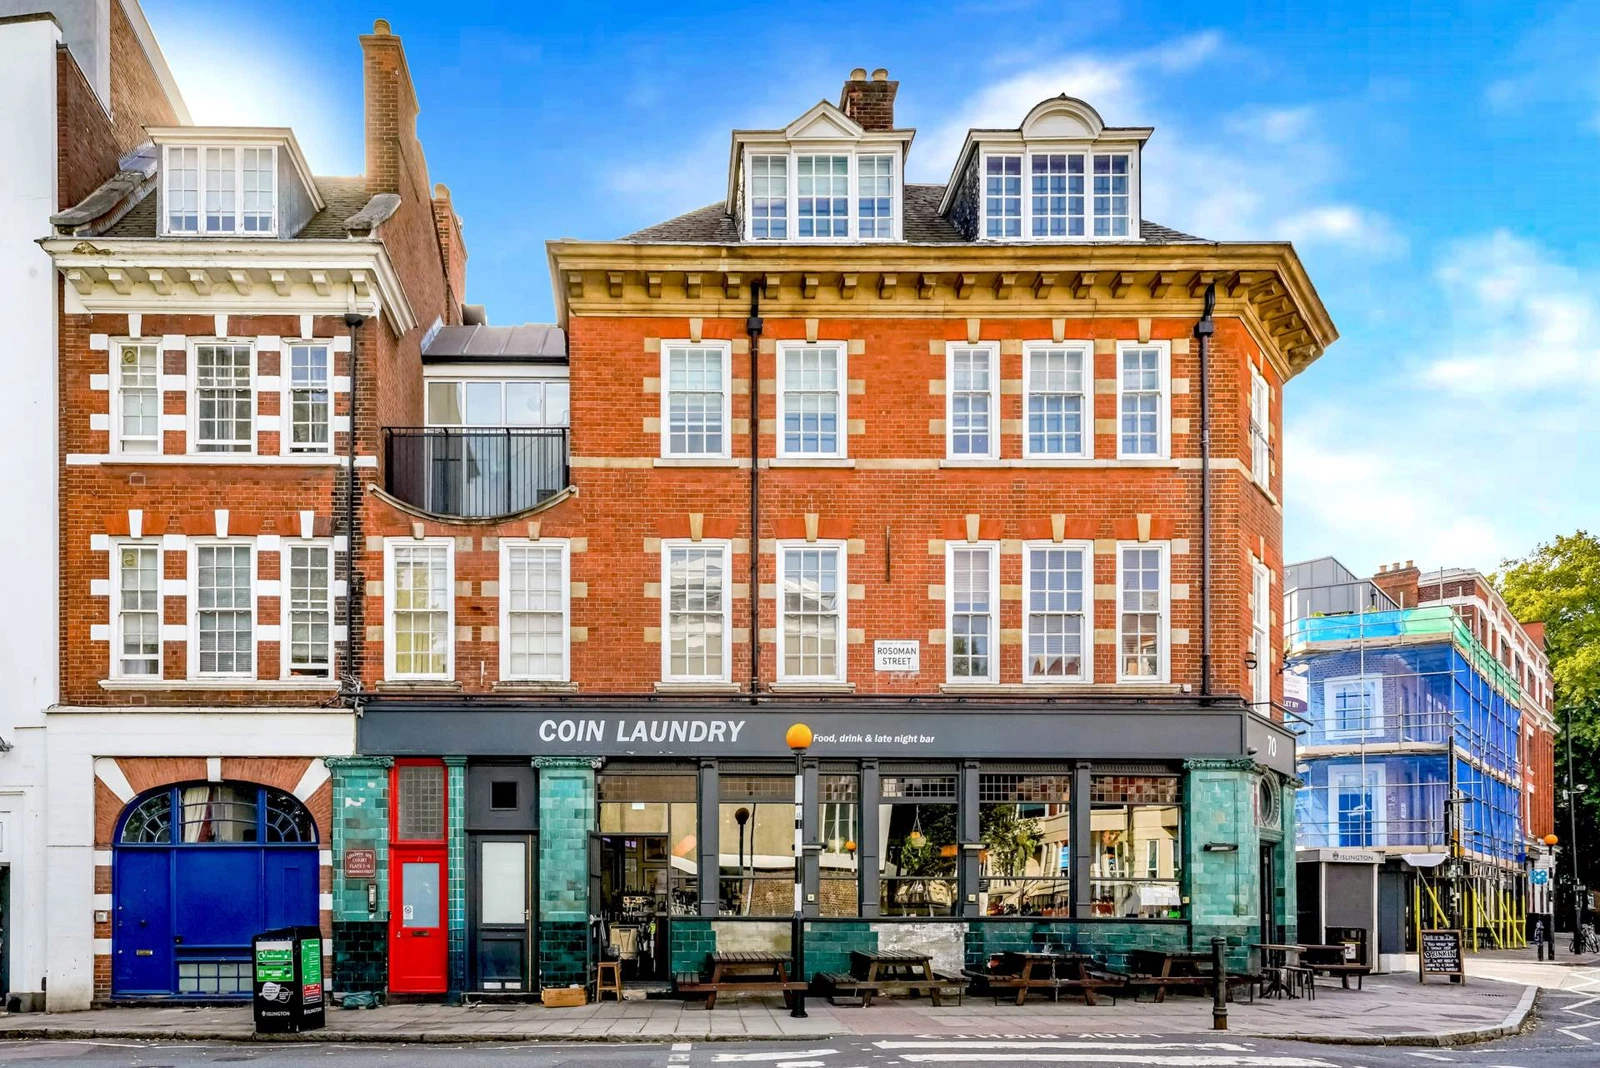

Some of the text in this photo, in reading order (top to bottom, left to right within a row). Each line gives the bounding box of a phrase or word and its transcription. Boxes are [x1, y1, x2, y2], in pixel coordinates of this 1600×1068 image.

[538, 719, 746, 743] COIN LAUNDRY
[812, 733, 935, 745] Food, drink & late night bar
[1267, 734, 1277, 757] 70
